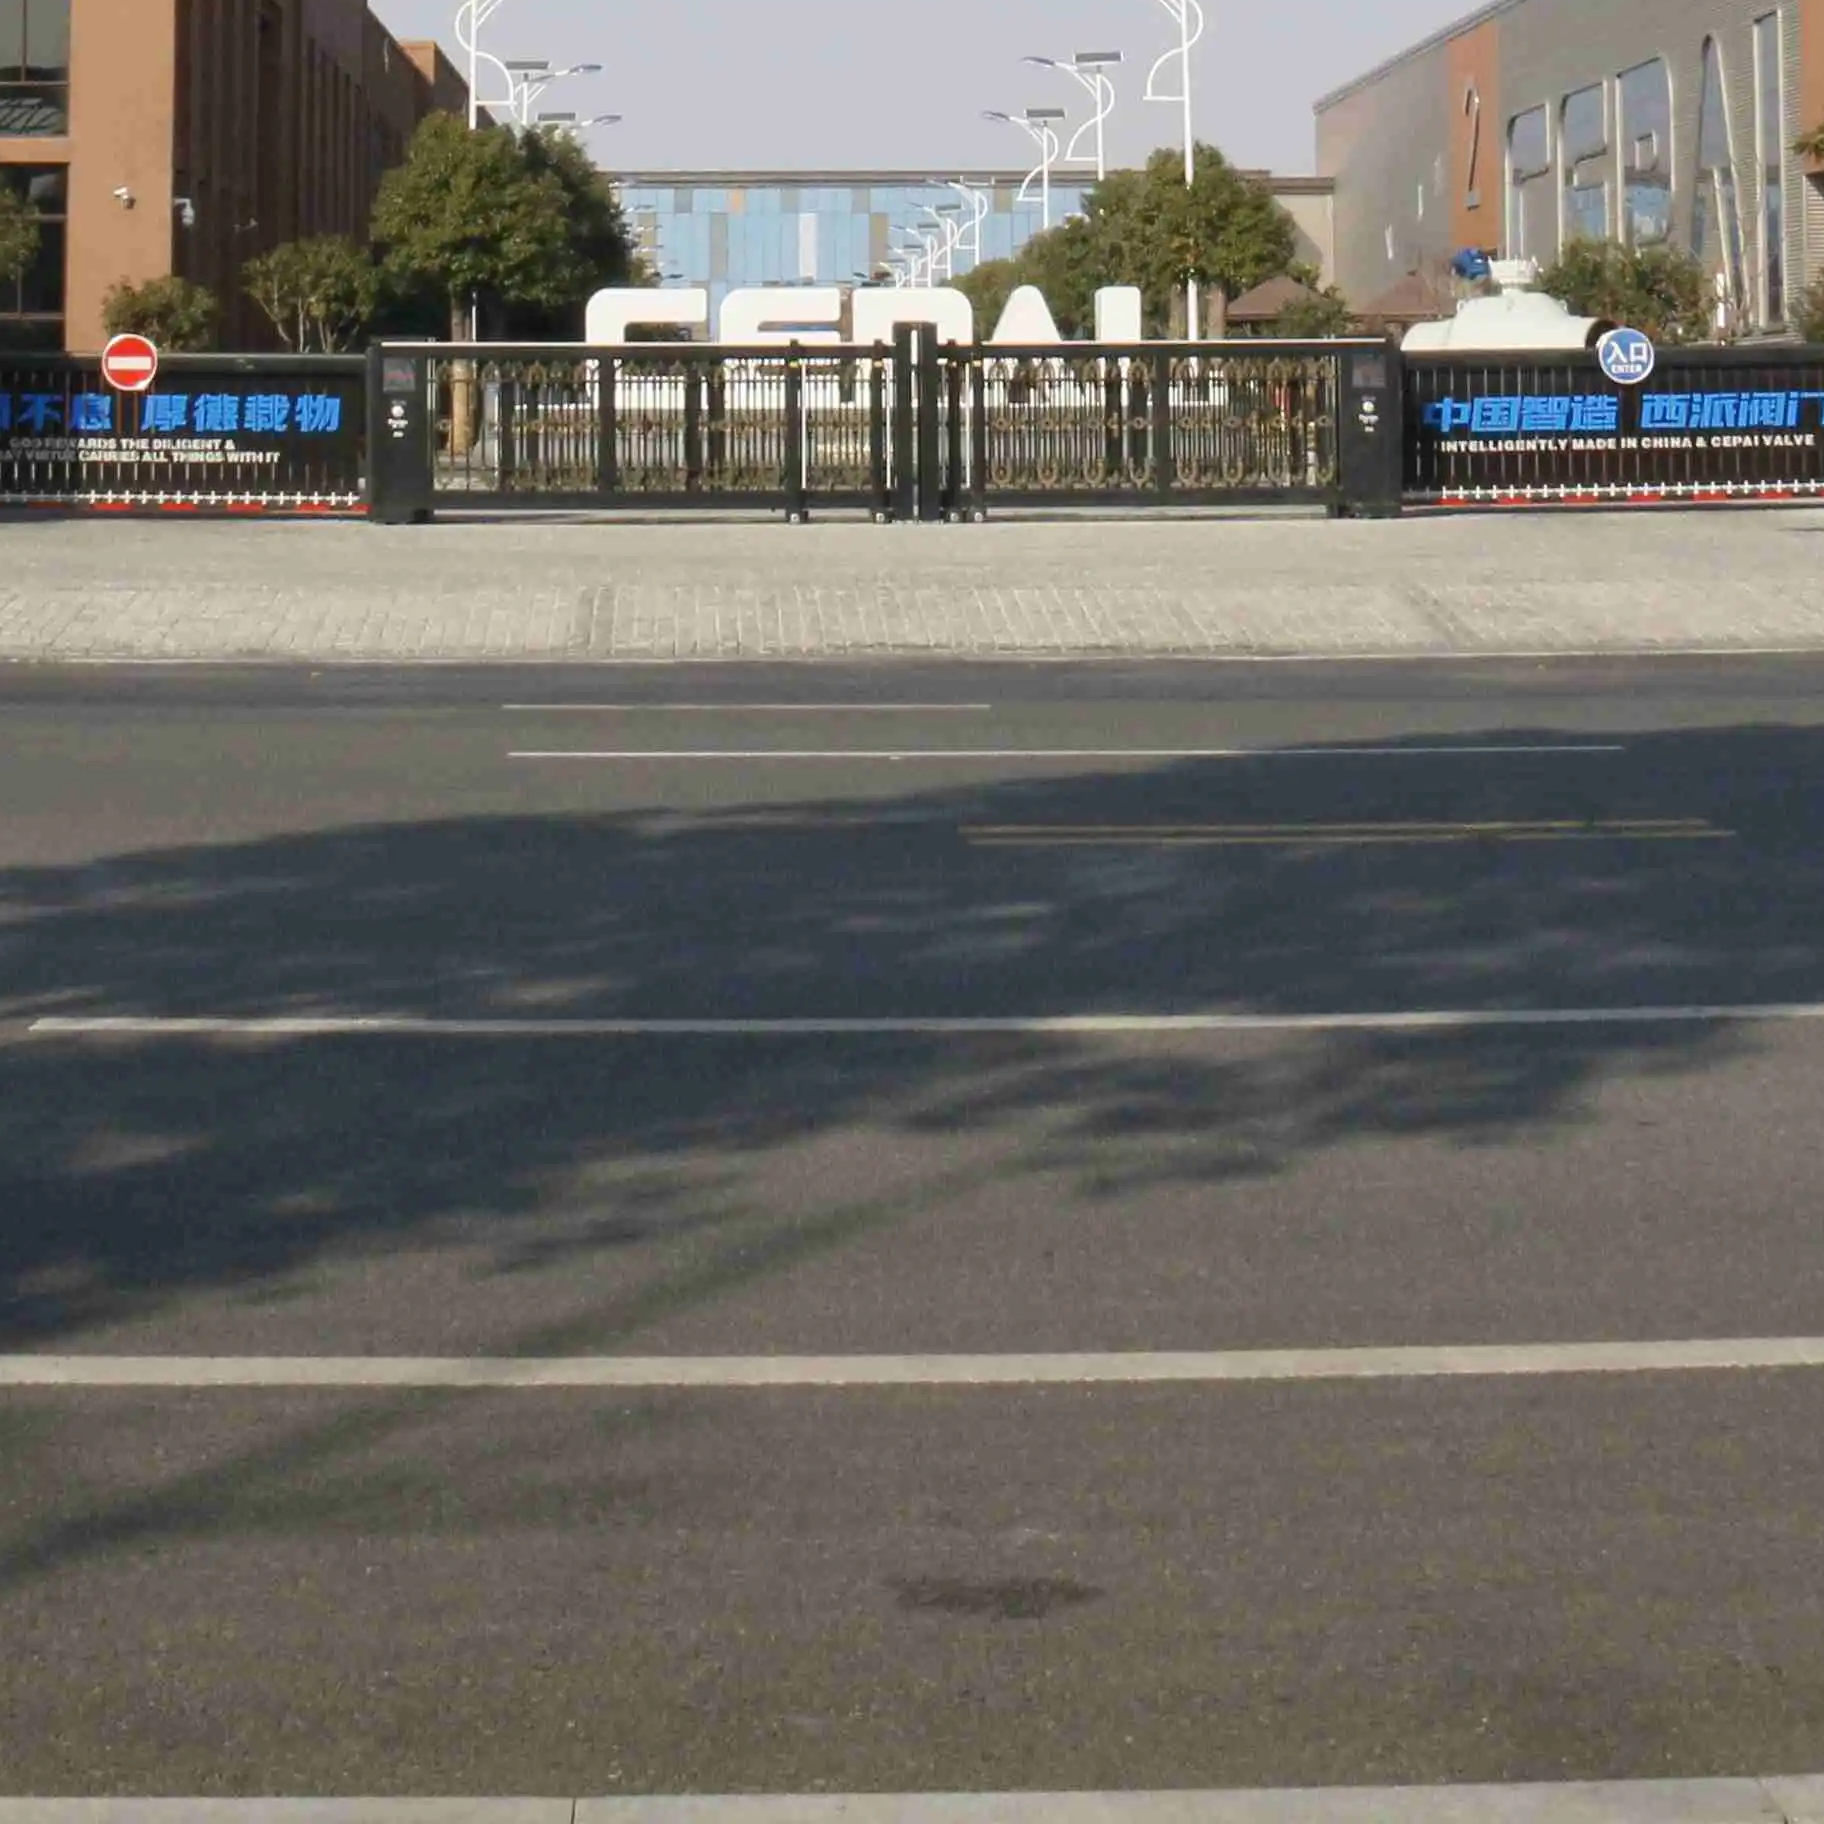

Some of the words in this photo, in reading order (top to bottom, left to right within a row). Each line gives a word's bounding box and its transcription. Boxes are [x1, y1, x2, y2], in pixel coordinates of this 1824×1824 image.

[1607, 340, 1648, 364] 入口
[1611, 364, 1643, 374] ENTER
[1423, 394, 1618, 433] 中国智造
[120, 438, 150, 450] THE
[152, 438, 222, 450] DILIGENT
[224, 438, 236, 450] &
[1440, 438, 1568, 453] INTELLIGENTLY
[1571, 438, 1617, 451] MADE
[1620, 437, 1638, 449] IN
[1641, 436, 1693, 449] CHINA
[1695, 435, 1707, 449] &
[1710, 434, 1760, 448] CEPAI
[1762, 433, 1816, 447] VALVE
[78, 450, 140, 462] CARRIES
[141, 451, 169, 463] ALL
[171, 451, 225, 463] THINGS
[226, 451, 264, 463] WITH
[265, 451, 281, 463] IT
